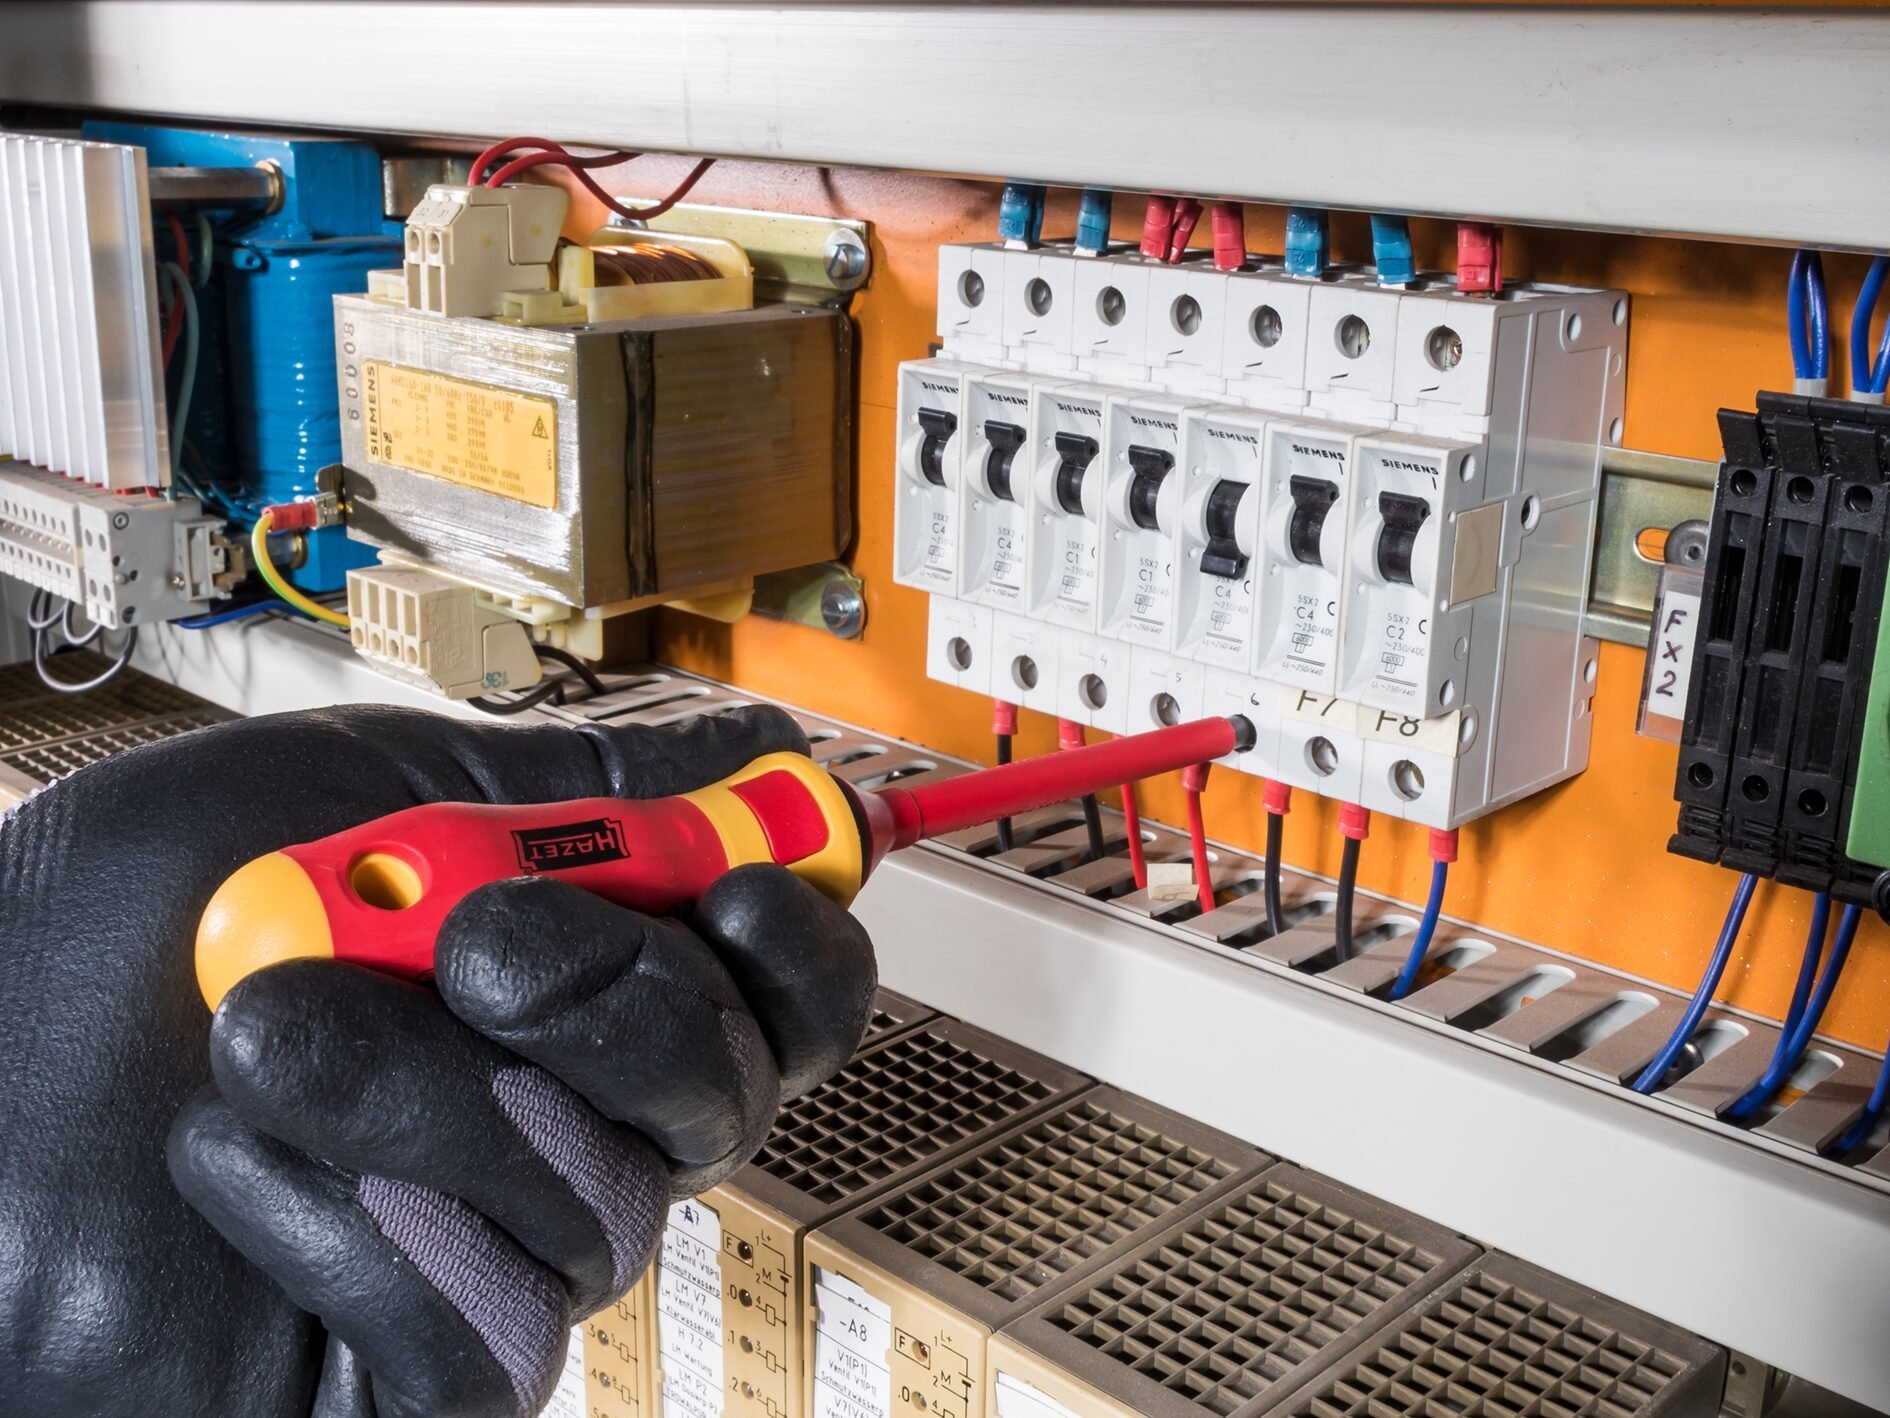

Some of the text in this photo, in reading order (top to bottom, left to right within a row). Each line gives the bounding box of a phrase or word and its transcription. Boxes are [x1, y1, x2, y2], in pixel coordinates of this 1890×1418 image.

[367, 365, 379, 457] SIEMENS
[1057, 403, 1101, 417] SIEMENS
[1131, 416, 1178, 431] SIEMENS
[1208, 428, 1258, 444] SIEMENS
[1292, 444, 1345, 461] SIEMENS
[1382, 459, 1439, 475] SIEMENS
[1139, 569, 1152, 582] C1
[1215, 585, 1231, 598] C4
[1296, 606, 1314, 620] C4
[1387, 612, 1410, 625] 5SX2
[1386, 625, 1405, 640] C2
[1655, 609, 1688, 697] FX2
[1250, 692, 1260, 706] 6
[530, 830, 616, 860] HAZET
[676, 1234, 706, 1261] LM V1
[726, 1236, 732, 1249] F
[762, 1268, 772, 1281] M
[676, 1279, 706, 1305] LM V7
[839, 1318, 867, 1342] -A8
[899, 1336, 906, 1348] F
[941, 1370, 951, 1384] M
